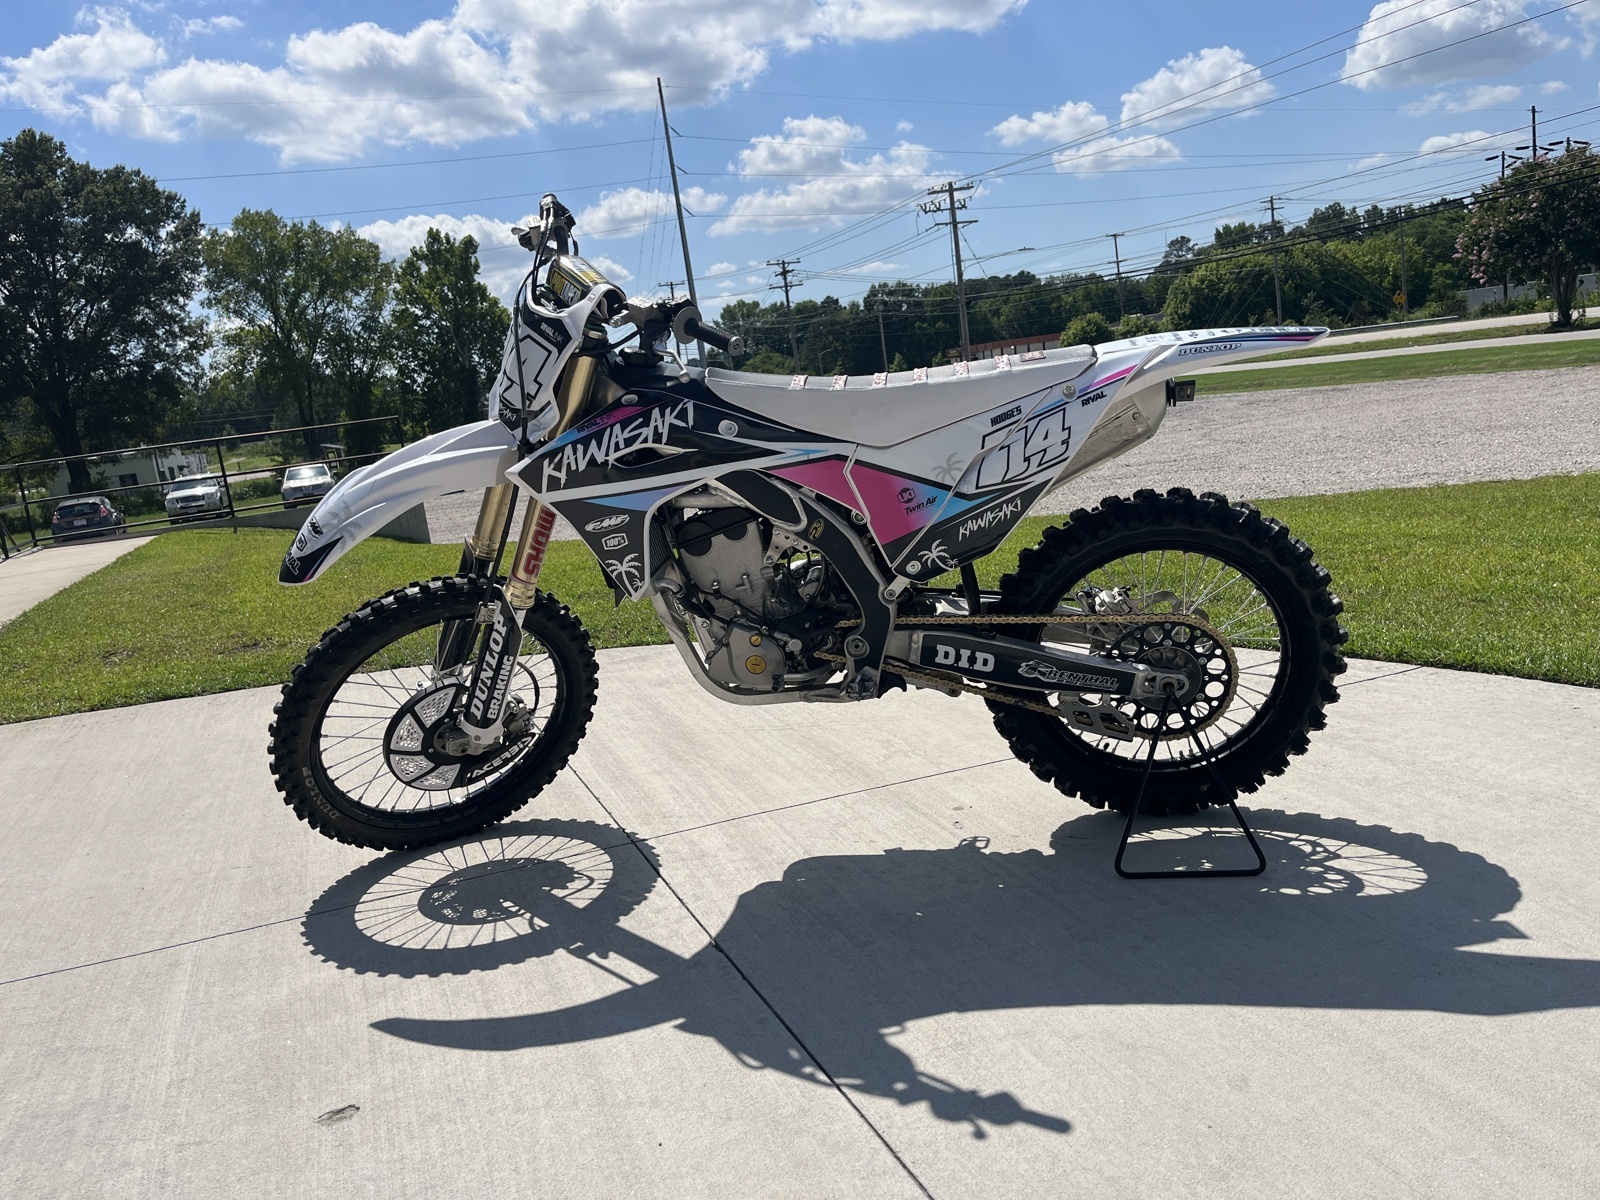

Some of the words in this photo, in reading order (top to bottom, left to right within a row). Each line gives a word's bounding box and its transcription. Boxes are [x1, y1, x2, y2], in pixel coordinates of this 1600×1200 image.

[1178, 342, 1242, 357] DUNLOP
[1081, 391, 1107, 407] RIVAL
[576, 420, 600, 434] RIVAL
[599, 412, 616, 424] INK
[990, 405, 1022, 428] HODGES
[542, 399, 694, 494] KAWASAKI
[904, 502, 925, 515] Twin
[925, 495, 938, 506] Air
[585, 514, 630, 532] FMF
[958, 496, 1022, 543] KAWASAKI
[605, 536, 625, 548] 100%
[470, 614, 510, 721] DUNLOP
[1047, 669, 1119, 686] RENTHAL
[486, 654, 514, 721] BRAKING
[302, 766, 341, 820] DUNLOP
